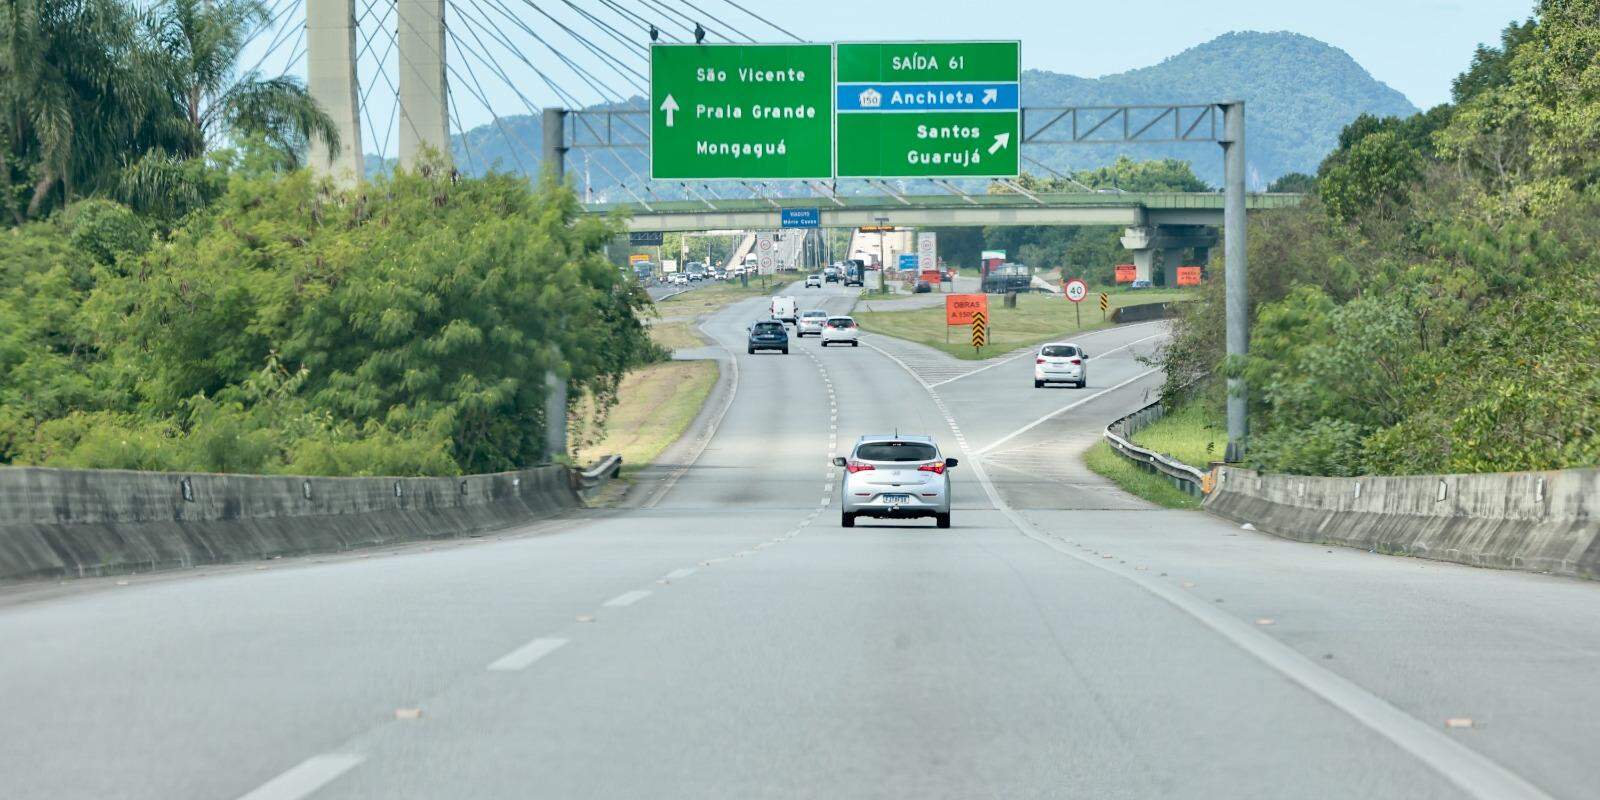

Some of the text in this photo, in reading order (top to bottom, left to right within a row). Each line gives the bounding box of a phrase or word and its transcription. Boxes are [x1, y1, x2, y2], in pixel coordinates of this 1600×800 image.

[892, 52, 964, 70] SAÍDA 61
[697, 67, 806, 82] São Vicente
[863, 90, 974, 105] 150 Anchieta
[696, 103, 816, 119] Praia Grande
[917, 124, 980, 138] Santos
[696, 139, 786, 158] Mongaguá
[907, 148, 980, 167] Guarujá
[1070, 286, 1083, 295] 40
[953, 301, 980, 309] OBRAS
